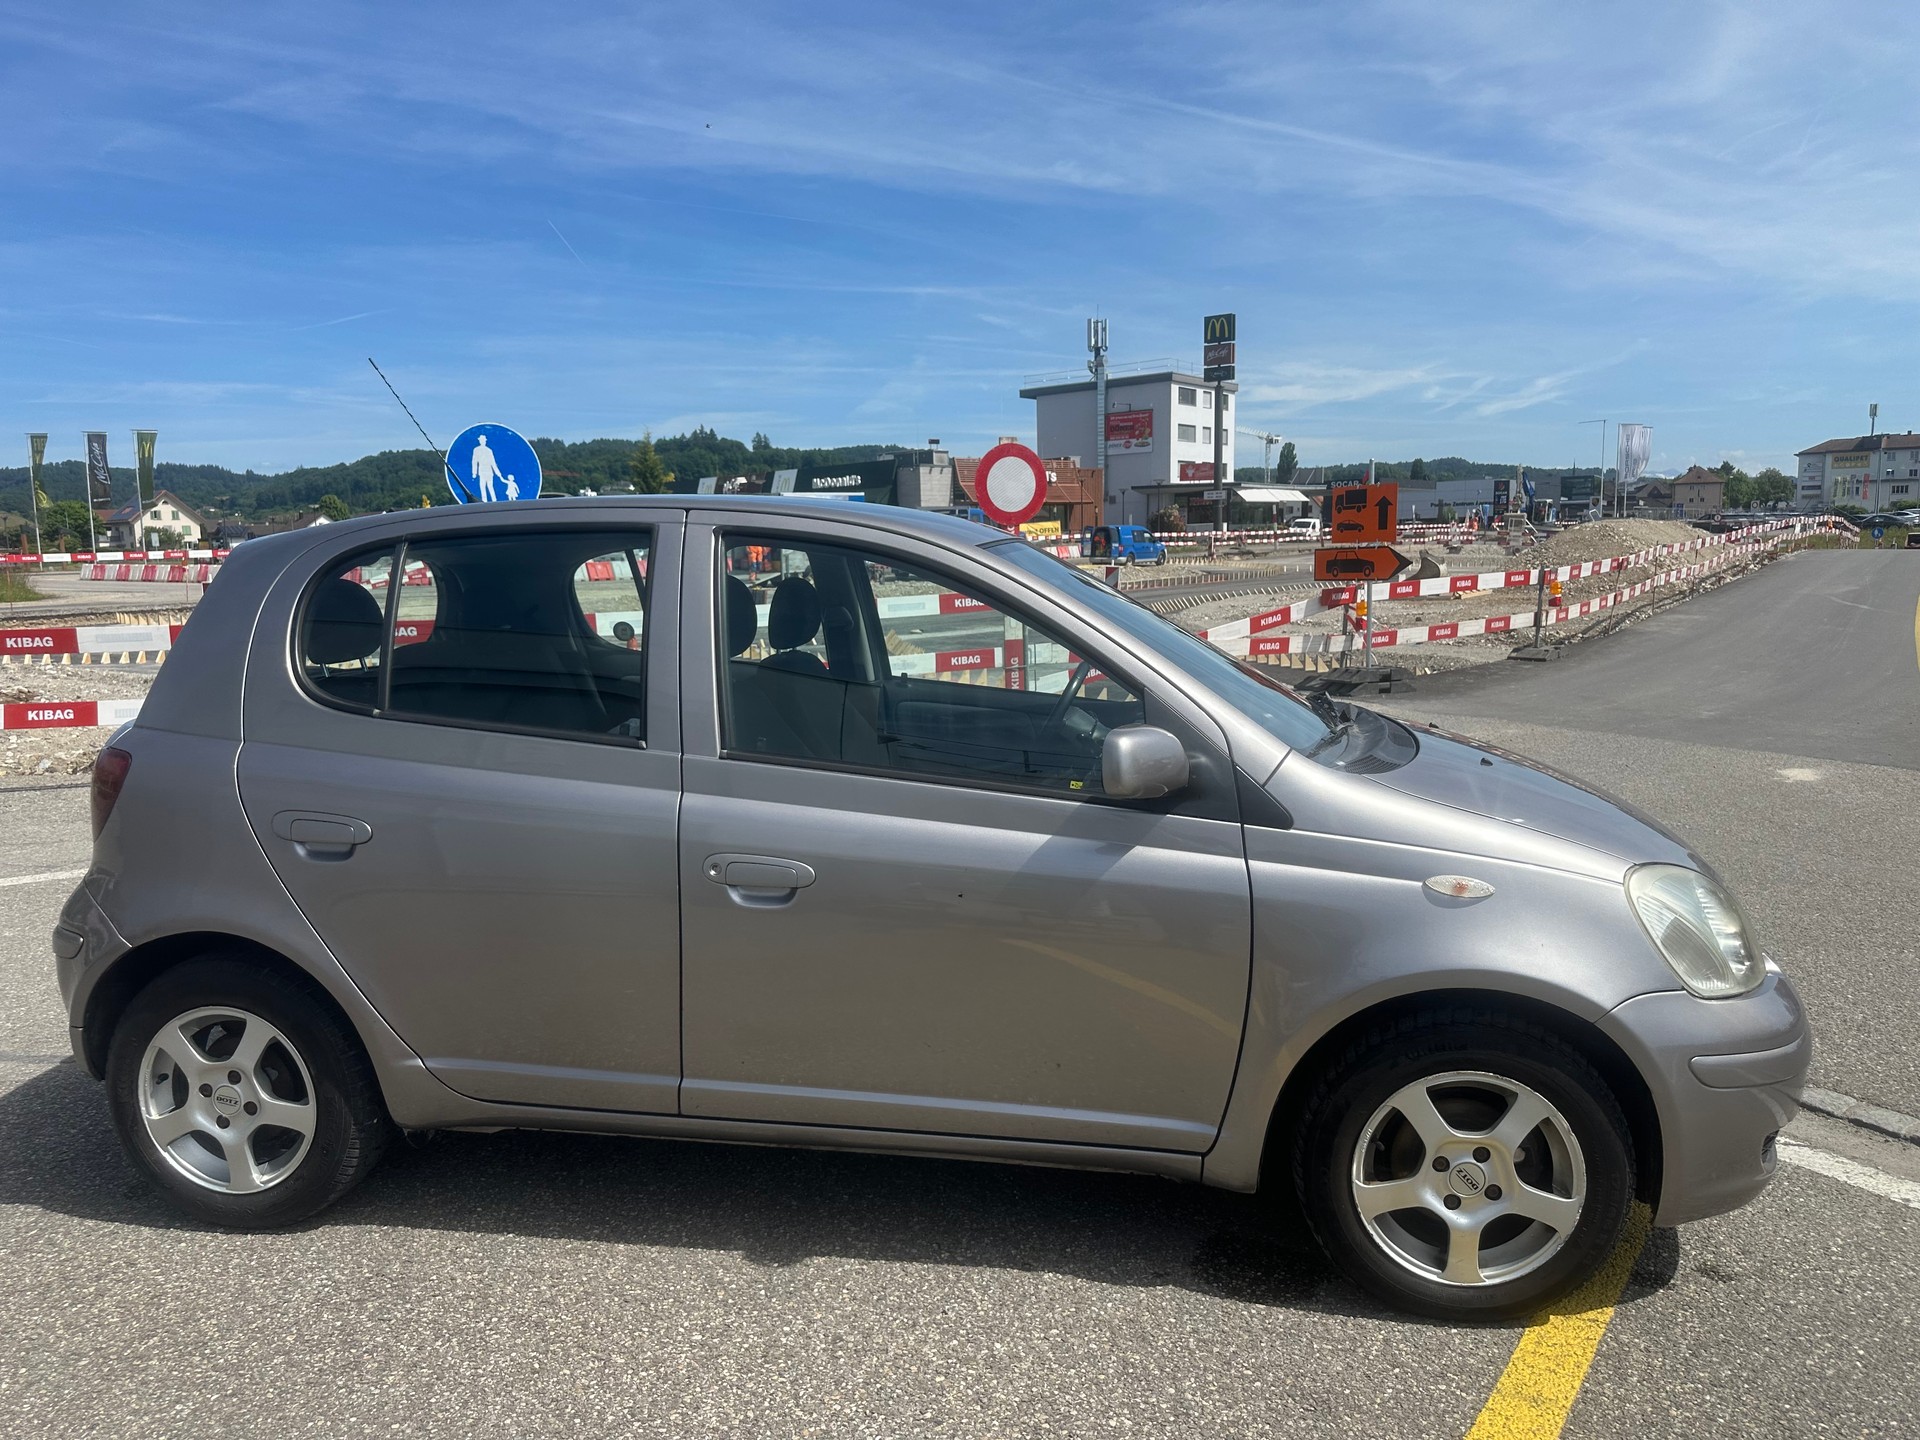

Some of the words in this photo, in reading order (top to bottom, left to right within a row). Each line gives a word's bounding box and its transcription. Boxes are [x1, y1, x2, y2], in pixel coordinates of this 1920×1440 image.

[1331, 480, 1360, 488] SOCAR
[1510, 574, 1525, 582] KIBAG
[1456, 579, 1472, 588] KIBAG
[1396, 585, 1413, 593] KIBAG
[1331, 591, 1350, 601] KIBAG
[1260, 613, 1282, 627] KIBAG
[1435, 627, 1451, 636] KIBAG
[5, 636, 54, 648] KIBAG
[1371, 635, 1389, 644] KIBAG
[1259, 642, 1280, 650] KIBAG
[951, 655, 981, 666] KIBAG
[27, 709, 74, 721] KIBAG
[216, 1096, 239, 1105] DOTZ
[1456, 1168, 1479, 1191] DOTZ
